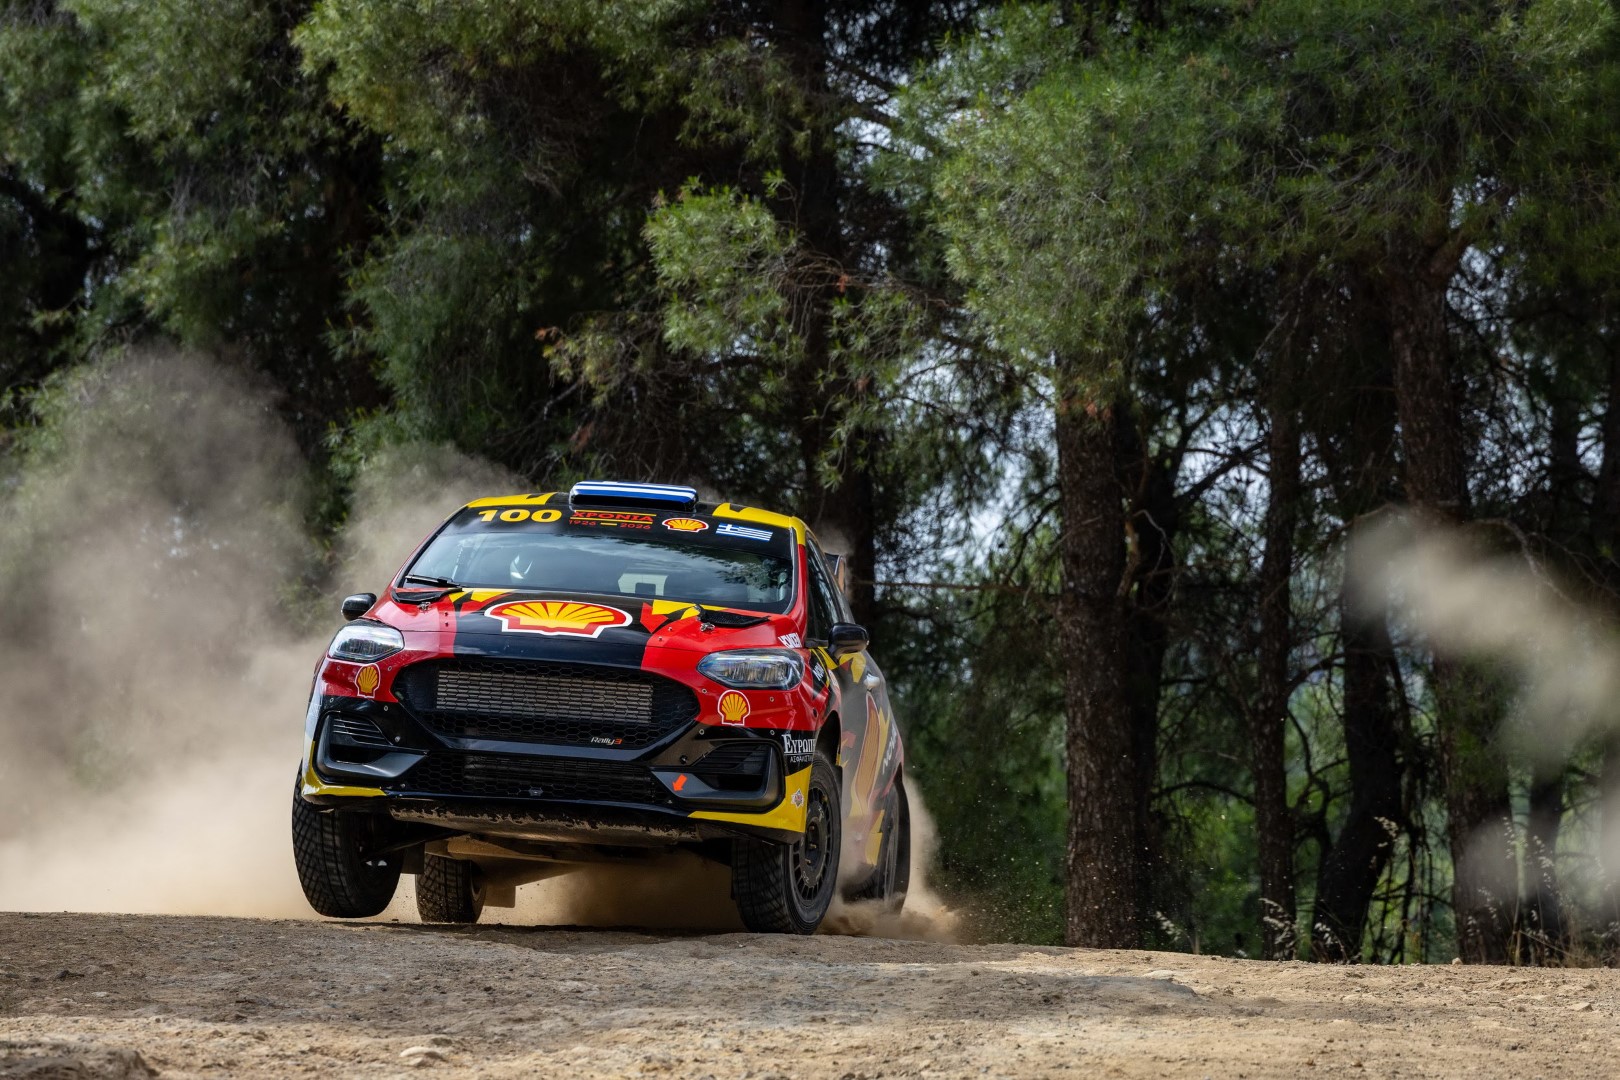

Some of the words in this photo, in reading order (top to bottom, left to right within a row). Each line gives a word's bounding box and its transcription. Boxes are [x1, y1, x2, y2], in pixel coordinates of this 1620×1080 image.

[478, 509, 562, 523] 100
[572, 511, 654, 522] ΧΡΟΝΙΑ
[620, 522, 651, 530] 2026
[590, 736, 623, 746] Rally3
